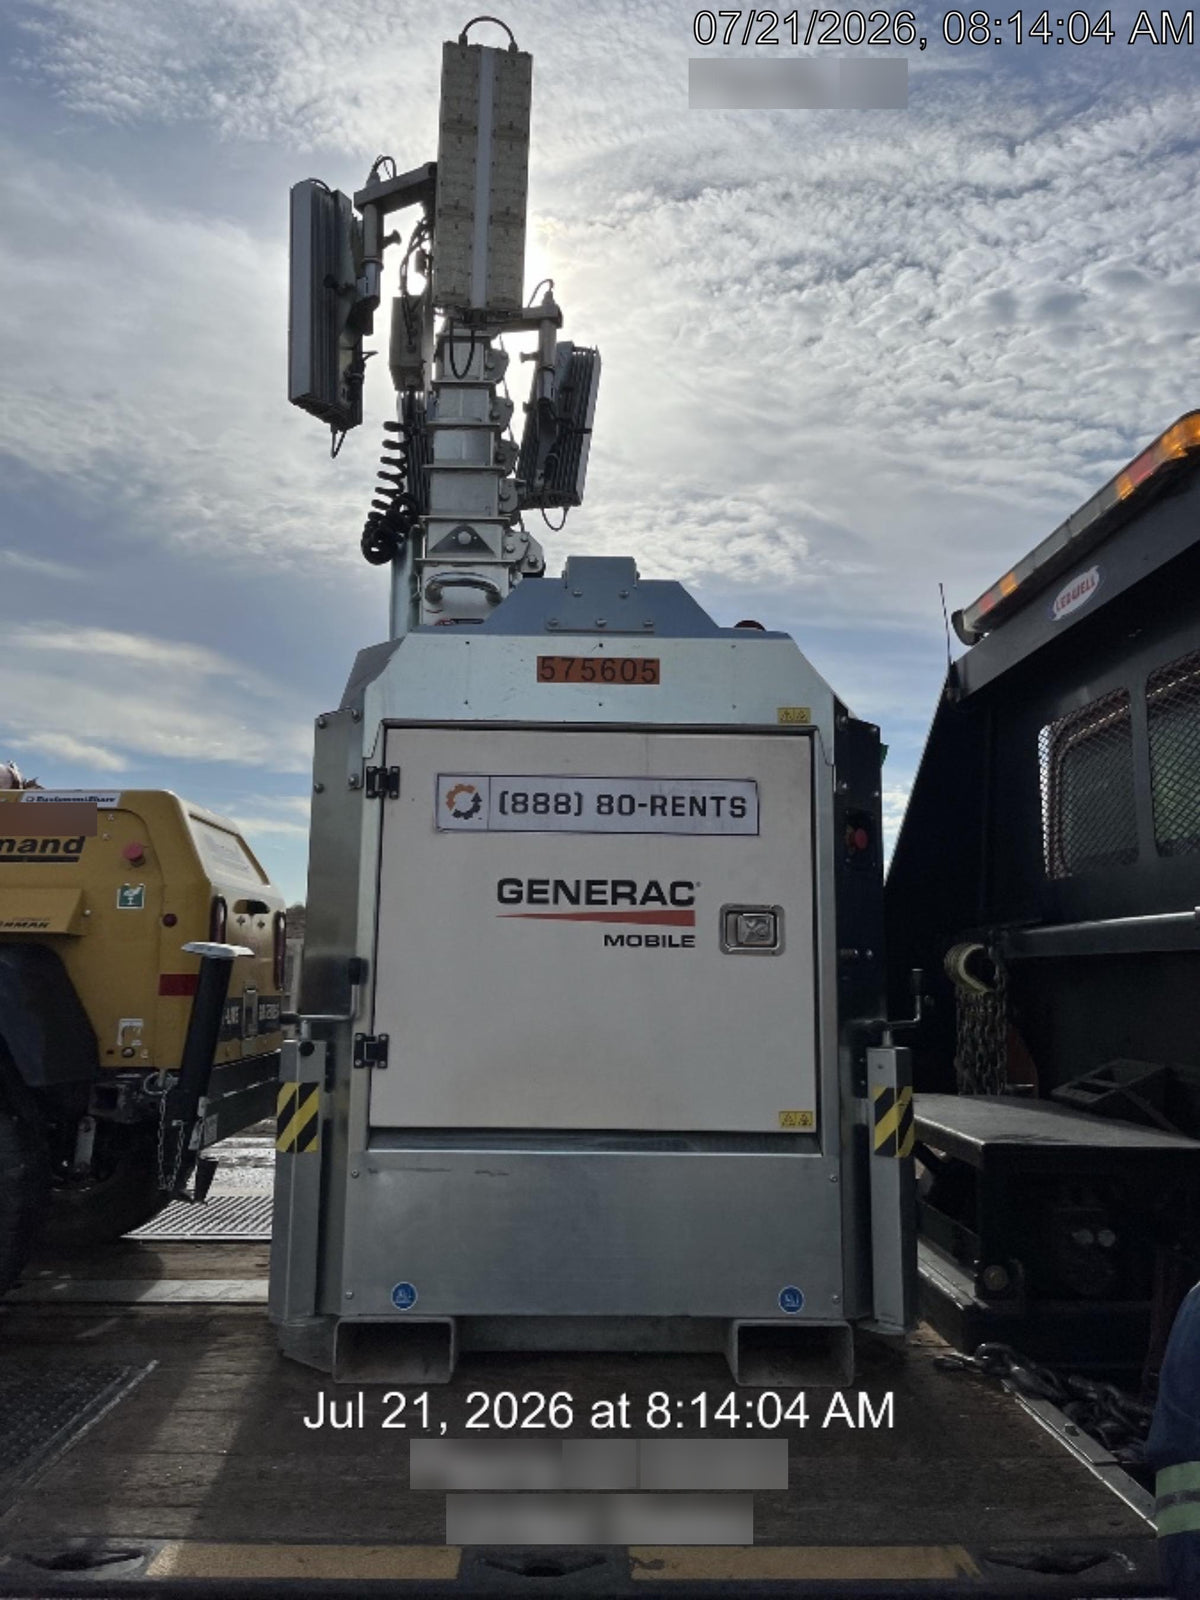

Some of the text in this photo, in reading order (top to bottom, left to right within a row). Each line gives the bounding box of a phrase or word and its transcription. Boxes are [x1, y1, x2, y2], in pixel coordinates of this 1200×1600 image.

[539, 657, 657, 683] 575605
[499, 790, 748, 819] (888) 80-RENTS
[496, 877, 696, 907] GENERAC
[603, 933, 696, 949] MOBILE
